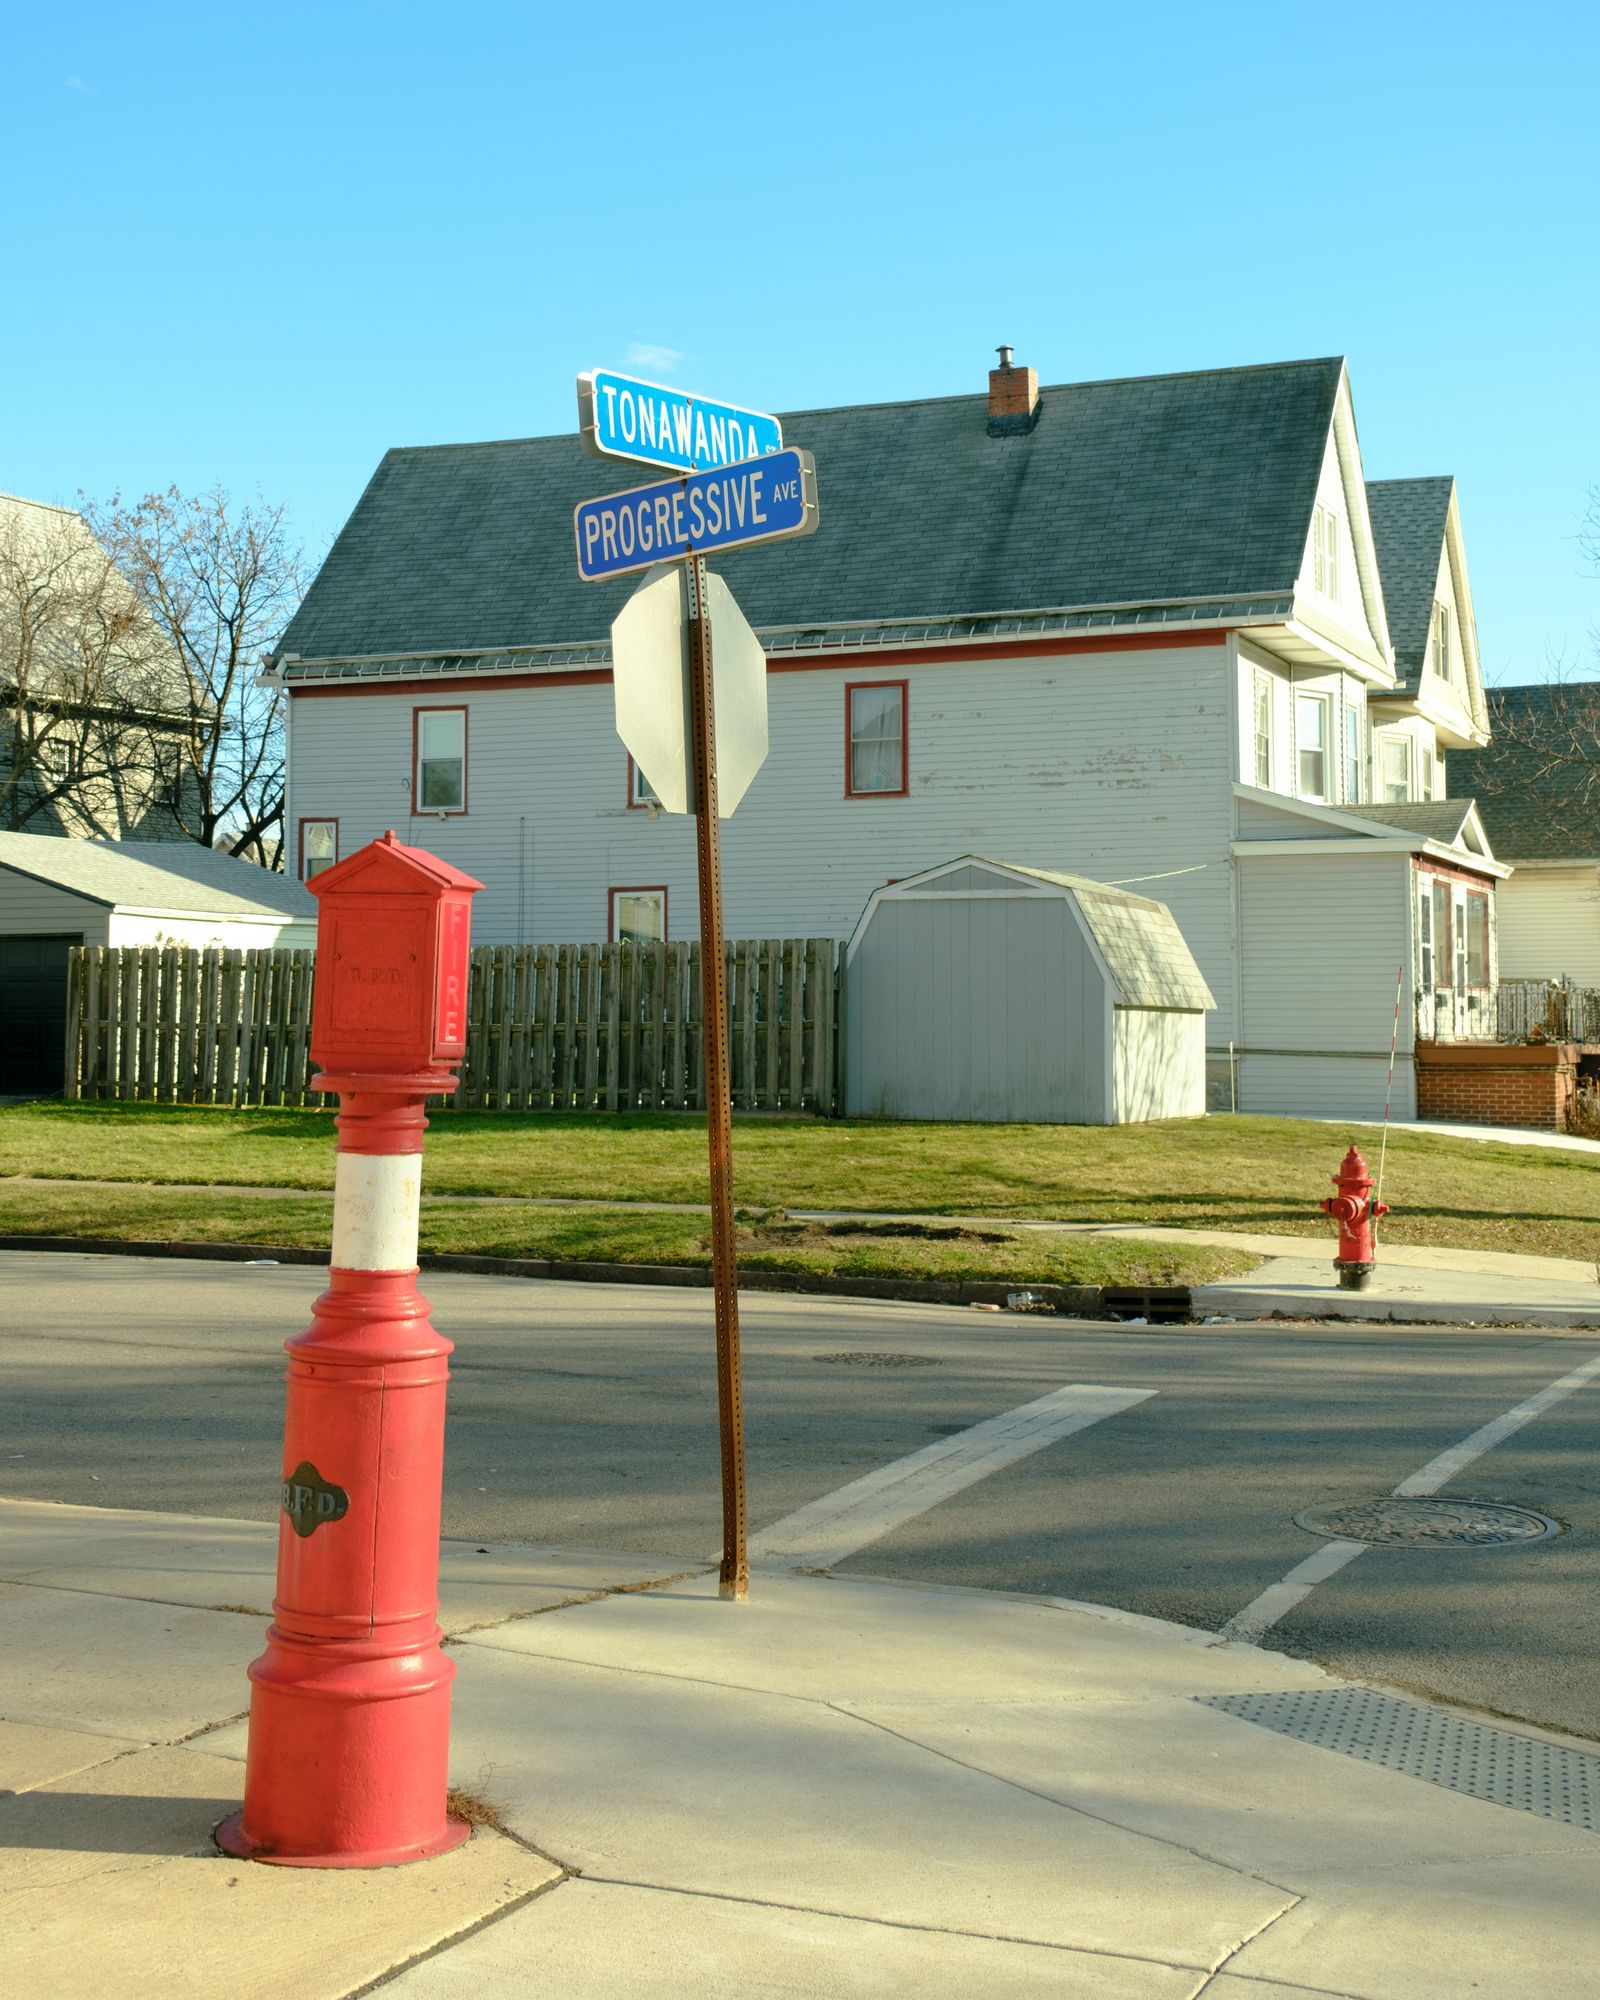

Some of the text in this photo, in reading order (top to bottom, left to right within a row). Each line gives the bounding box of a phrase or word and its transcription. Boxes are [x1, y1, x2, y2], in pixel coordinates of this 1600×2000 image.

[602, 384, 759, 464] TONAWANDA
[584, 471, 798, 565] PROGRESSIVE AVE
[445, 905, 462, 1042] FIRE
